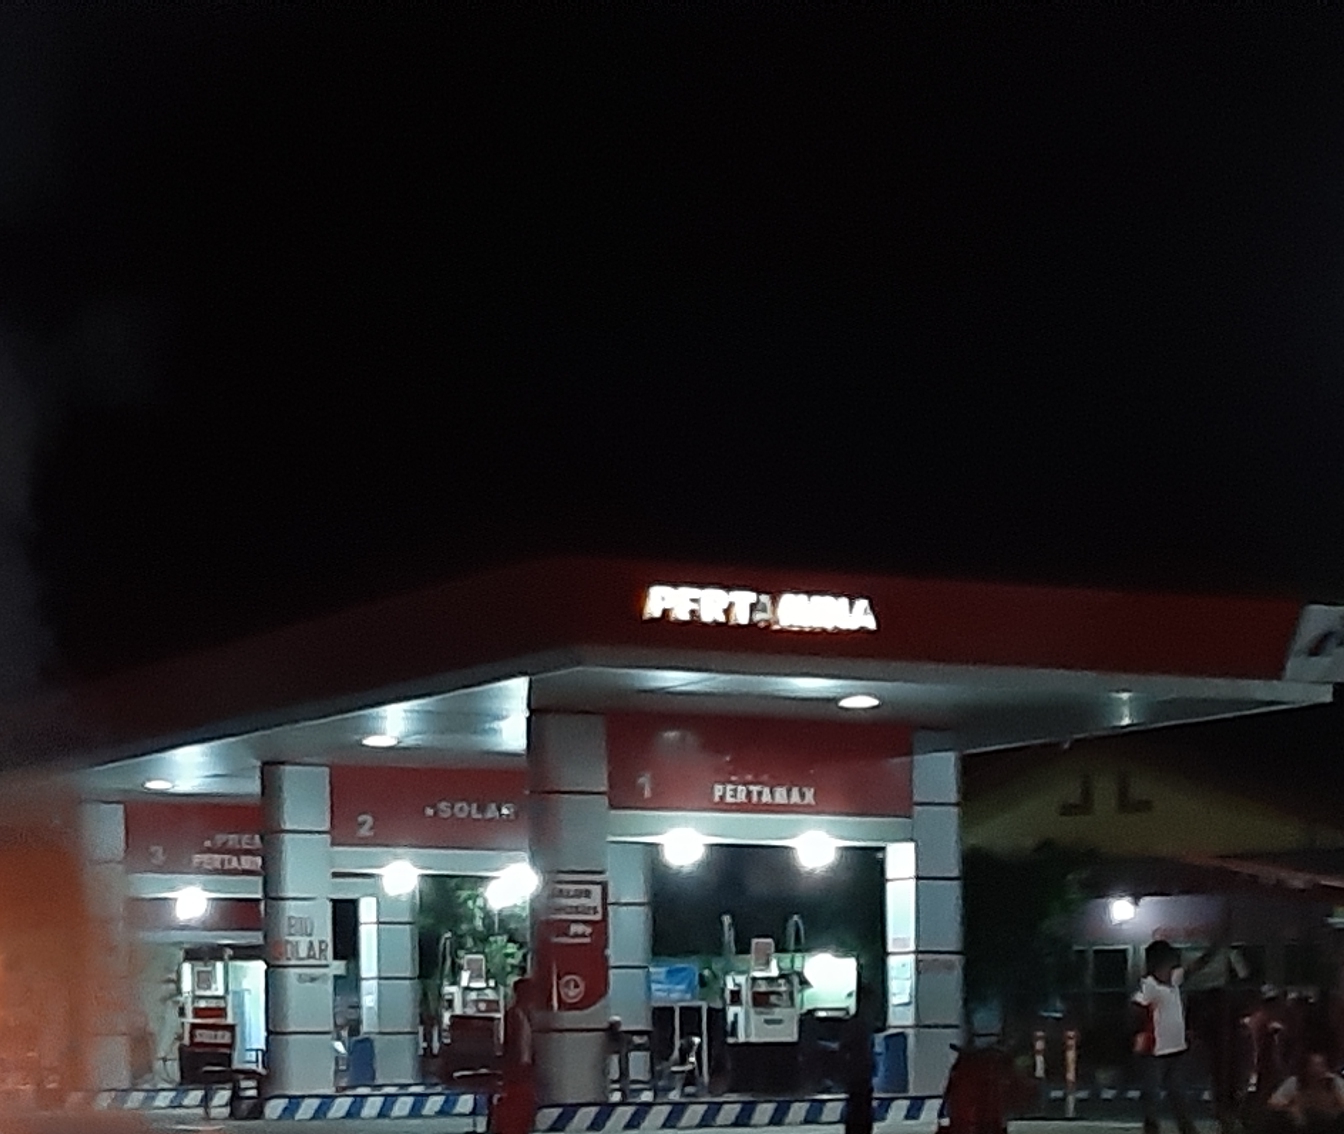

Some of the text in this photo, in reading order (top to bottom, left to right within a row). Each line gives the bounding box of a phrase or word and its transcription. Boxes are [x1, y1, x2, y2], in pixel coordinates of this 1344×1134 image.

[713, 784, 816, 805] PERTAMAX
[436, 801, 516, 820] SOLAR
[357, 814, 374, 837] 2
